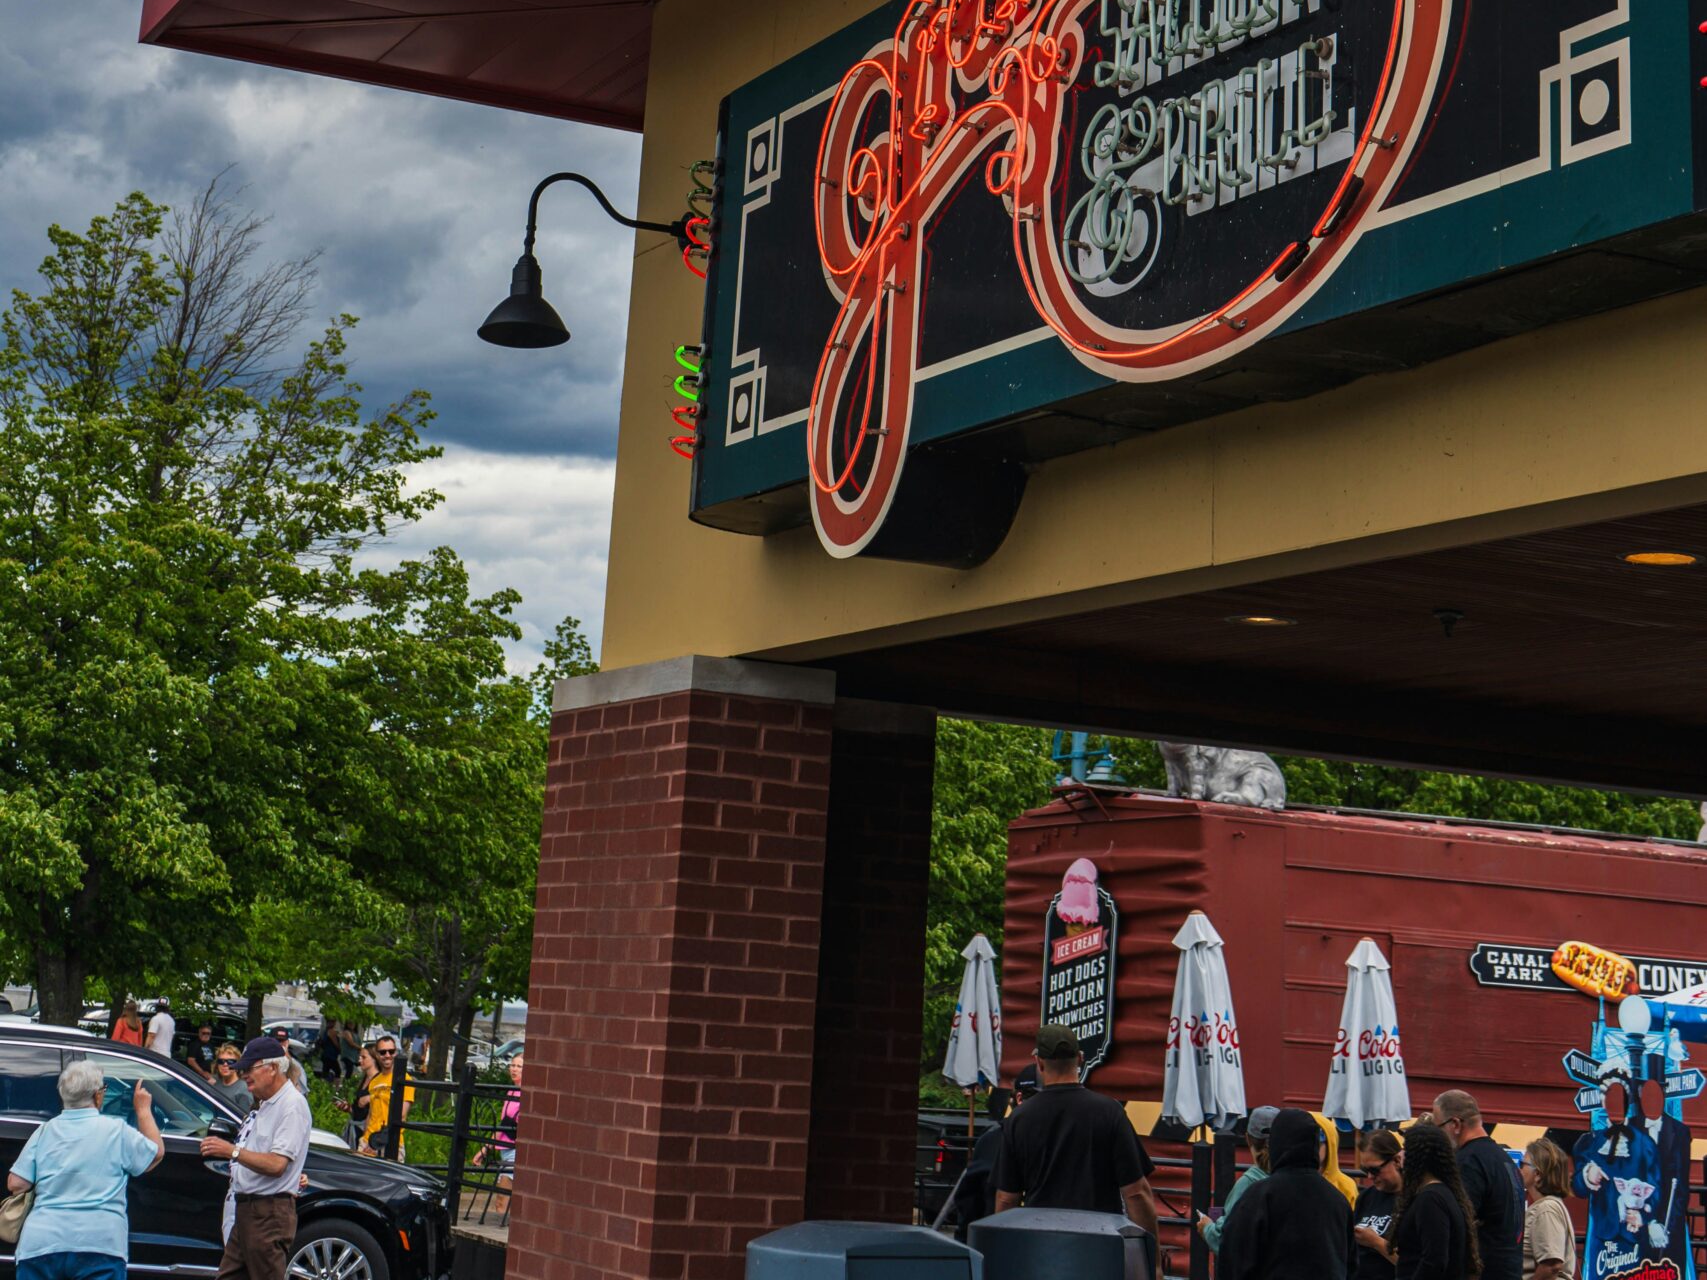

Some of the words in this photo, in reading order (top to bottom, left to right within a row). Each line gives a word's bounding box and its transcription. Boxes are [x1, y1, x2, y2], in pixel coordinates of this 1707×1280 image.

[1162, 33, 1356, 218] GRILL
[1057, 943, 1070, 959] ICE
[1072, 932, 1100, 953] CREAM
[1487, 951, 1549, 968] CANAL
[1050, 968, 1073, 992] HOT
[1075, 956, 1105, 982] DOGS
[1494, 966, 1544, 982] PARK
[1049, 978, 1104, 1014] POPCORN
[1596, 1244, 1639, 1276] Original
